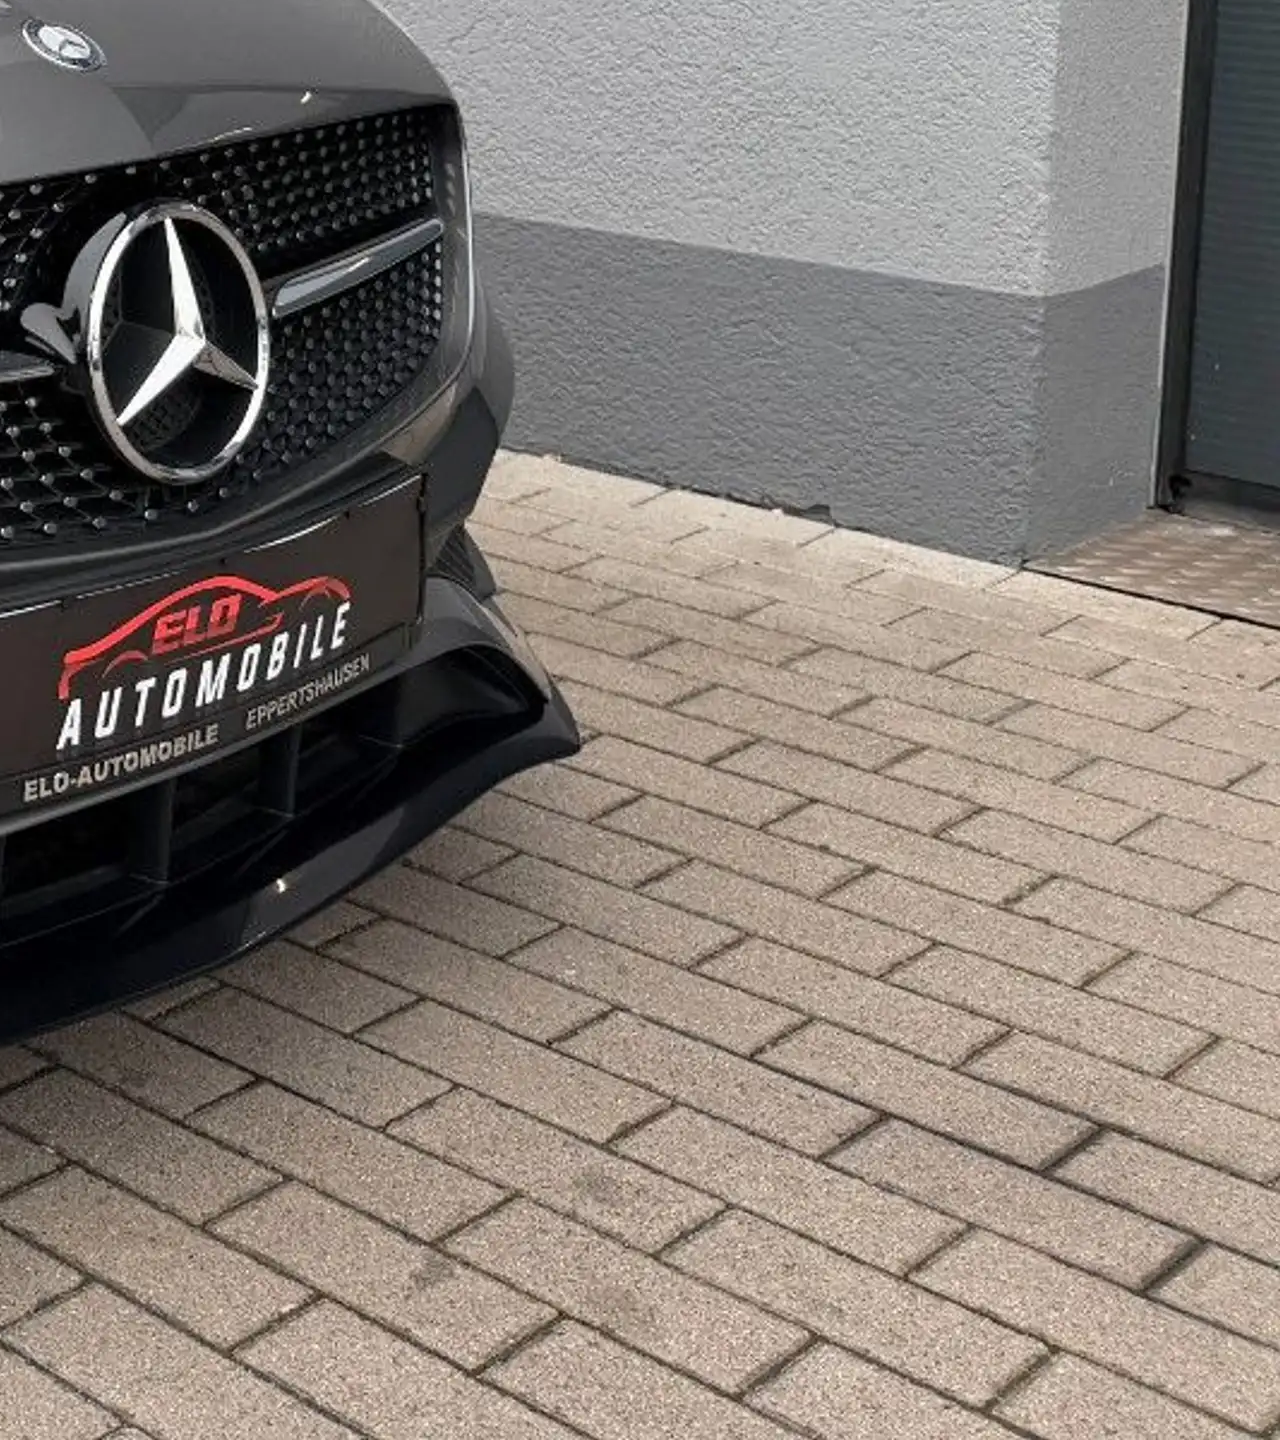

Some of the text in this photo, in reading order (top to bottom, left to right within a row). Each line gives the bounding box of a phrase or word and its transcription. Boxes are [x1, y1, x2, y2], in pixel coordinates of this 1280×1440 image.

[55, 602, 351, 751] AUTOMOBILE
[151, 593, 243, 655] ELO
[23, 652, 371, 803] ELO-AUTOMOBILE EPPERTSHAUSEN
